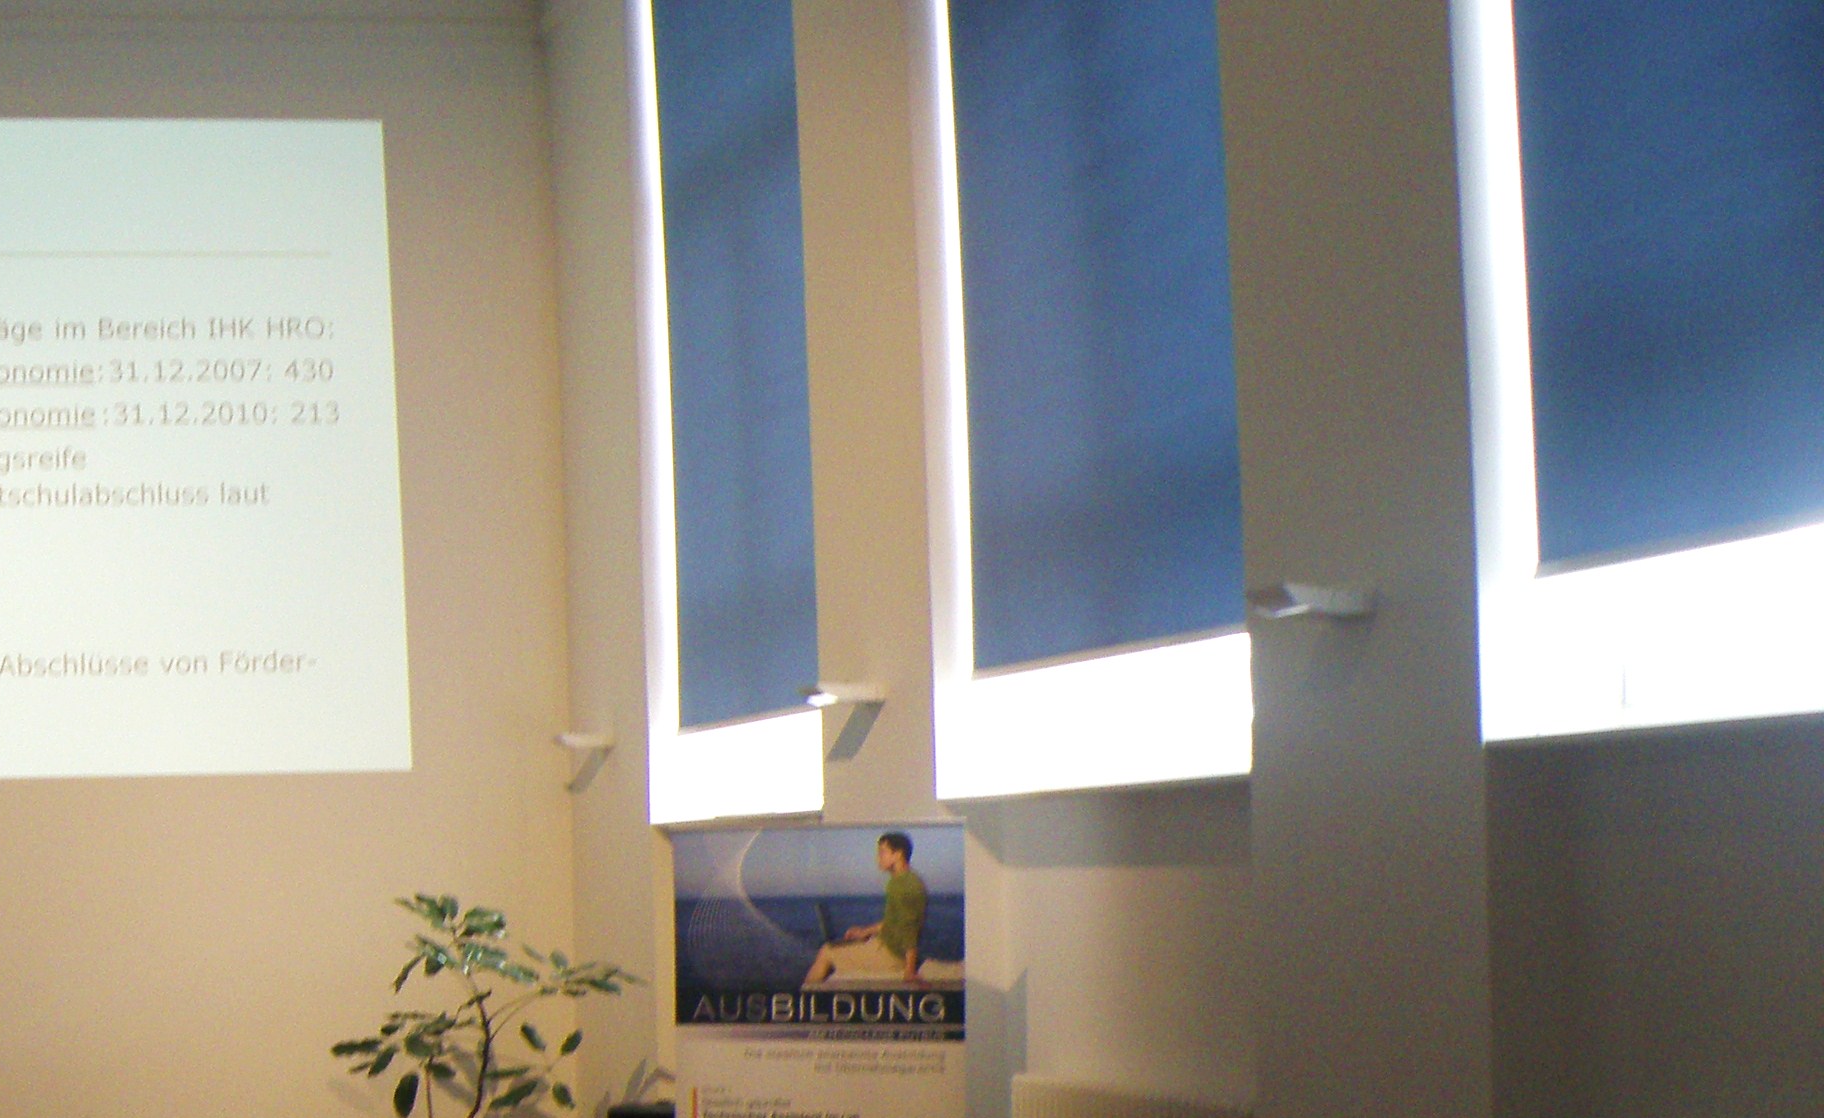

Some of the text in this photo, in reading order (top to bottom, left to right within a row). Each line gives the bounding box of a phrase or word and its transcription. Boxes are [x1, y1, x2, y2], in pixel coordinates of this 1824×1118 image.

[54, 317, 87, 341] im
[97, 315, 197, 342] Bereich
[208, 316, 254, 341] IHK
[266, 315, 334, 341] HRO:
[284, 357, 334, 384] 430
[290, 400, 340, 426] 213
[219, 480, 270, 506] laut
[159, 654, 209, 676] von
[218, 649, 317, 675] Förder-
[693, 992, 946, 1023] AUSBILDUNG
